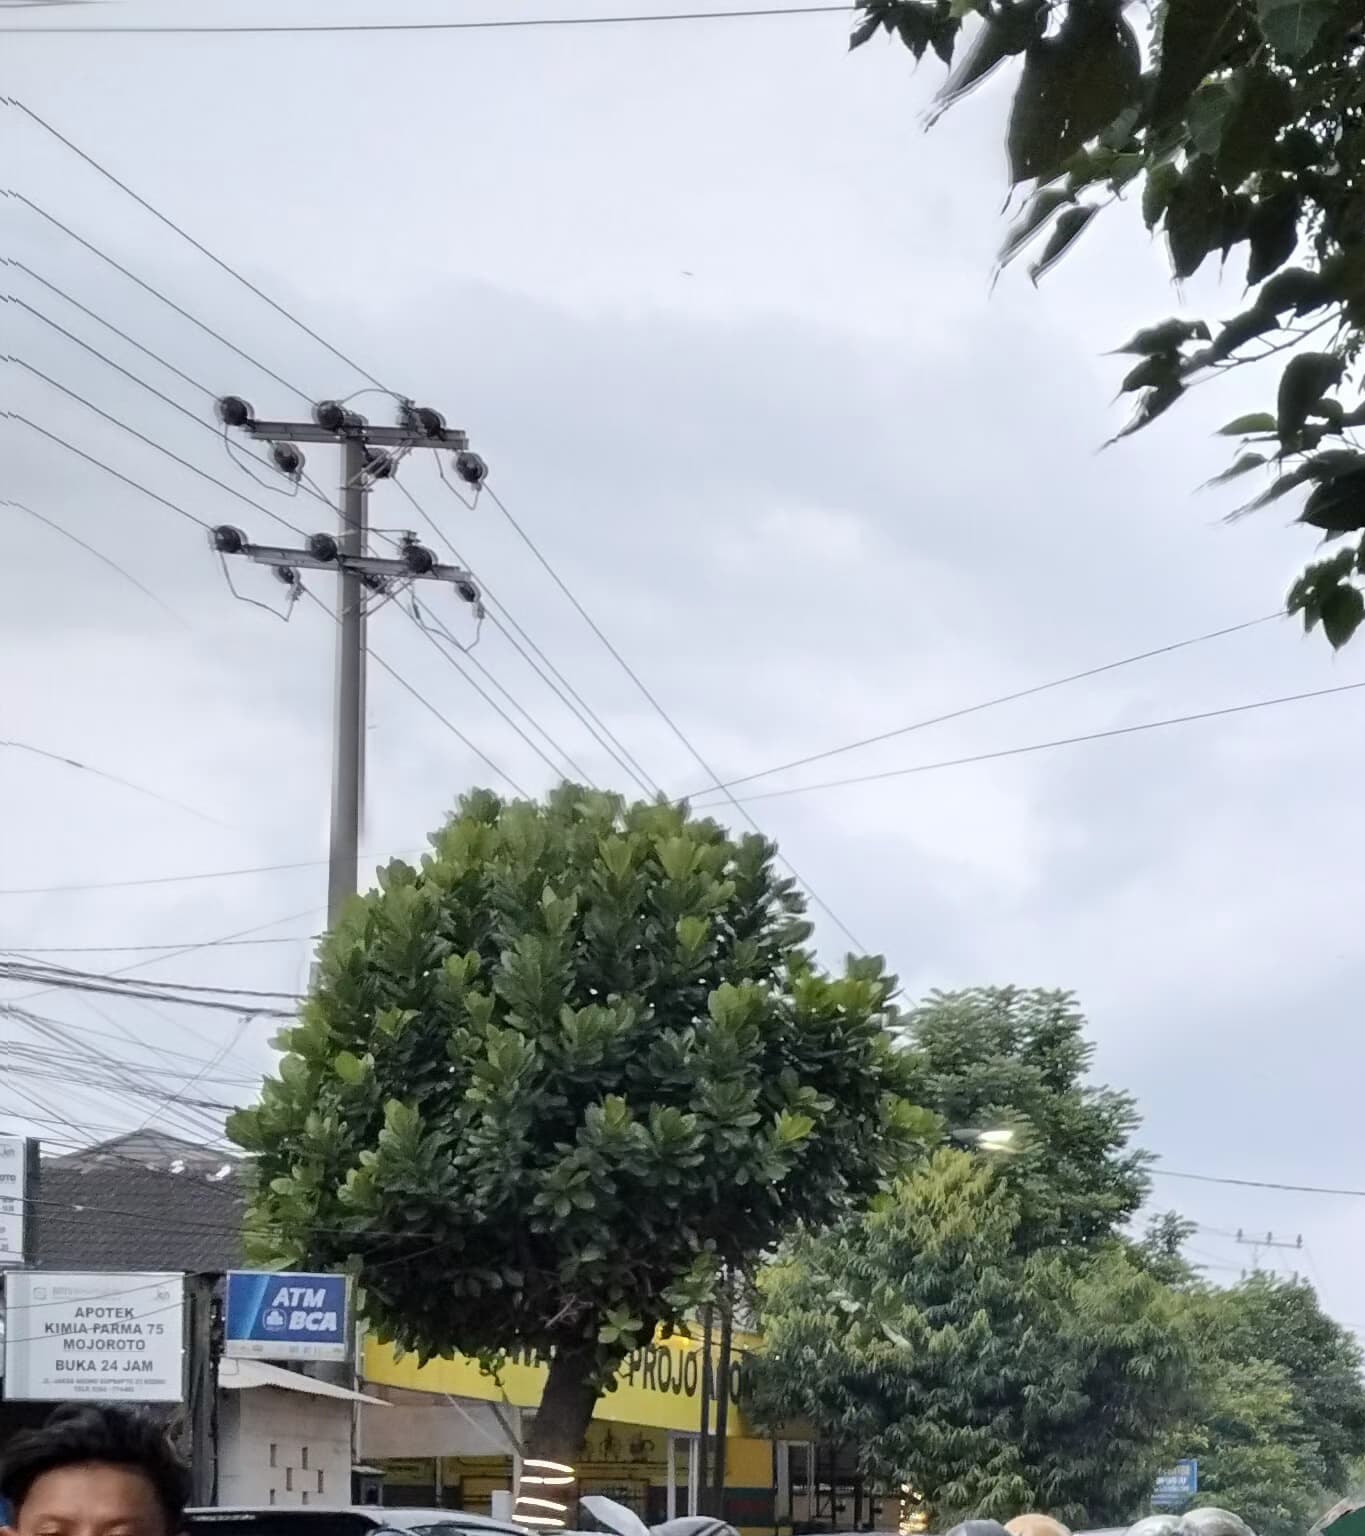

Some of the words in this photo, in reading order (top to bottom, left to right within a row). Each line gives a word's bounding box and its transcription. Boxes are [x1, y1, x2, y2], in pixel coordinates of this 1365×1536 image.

[272, 1287, 327, 1308] ATM
[74, 1306, 135, 1319] APOTEK
[288, 1310, 338, 1331] BCA
[44, 1322, 88, 1335] KIMIA
[147, 1323, 165, 1335] 75
[63, 1338, 146, 1351] MOJOROTO
[55, 1359, 97, 1372] BUKA
[100, 1360, 118, 1372] 24
[122, 1360, 153, 1372] JAM
